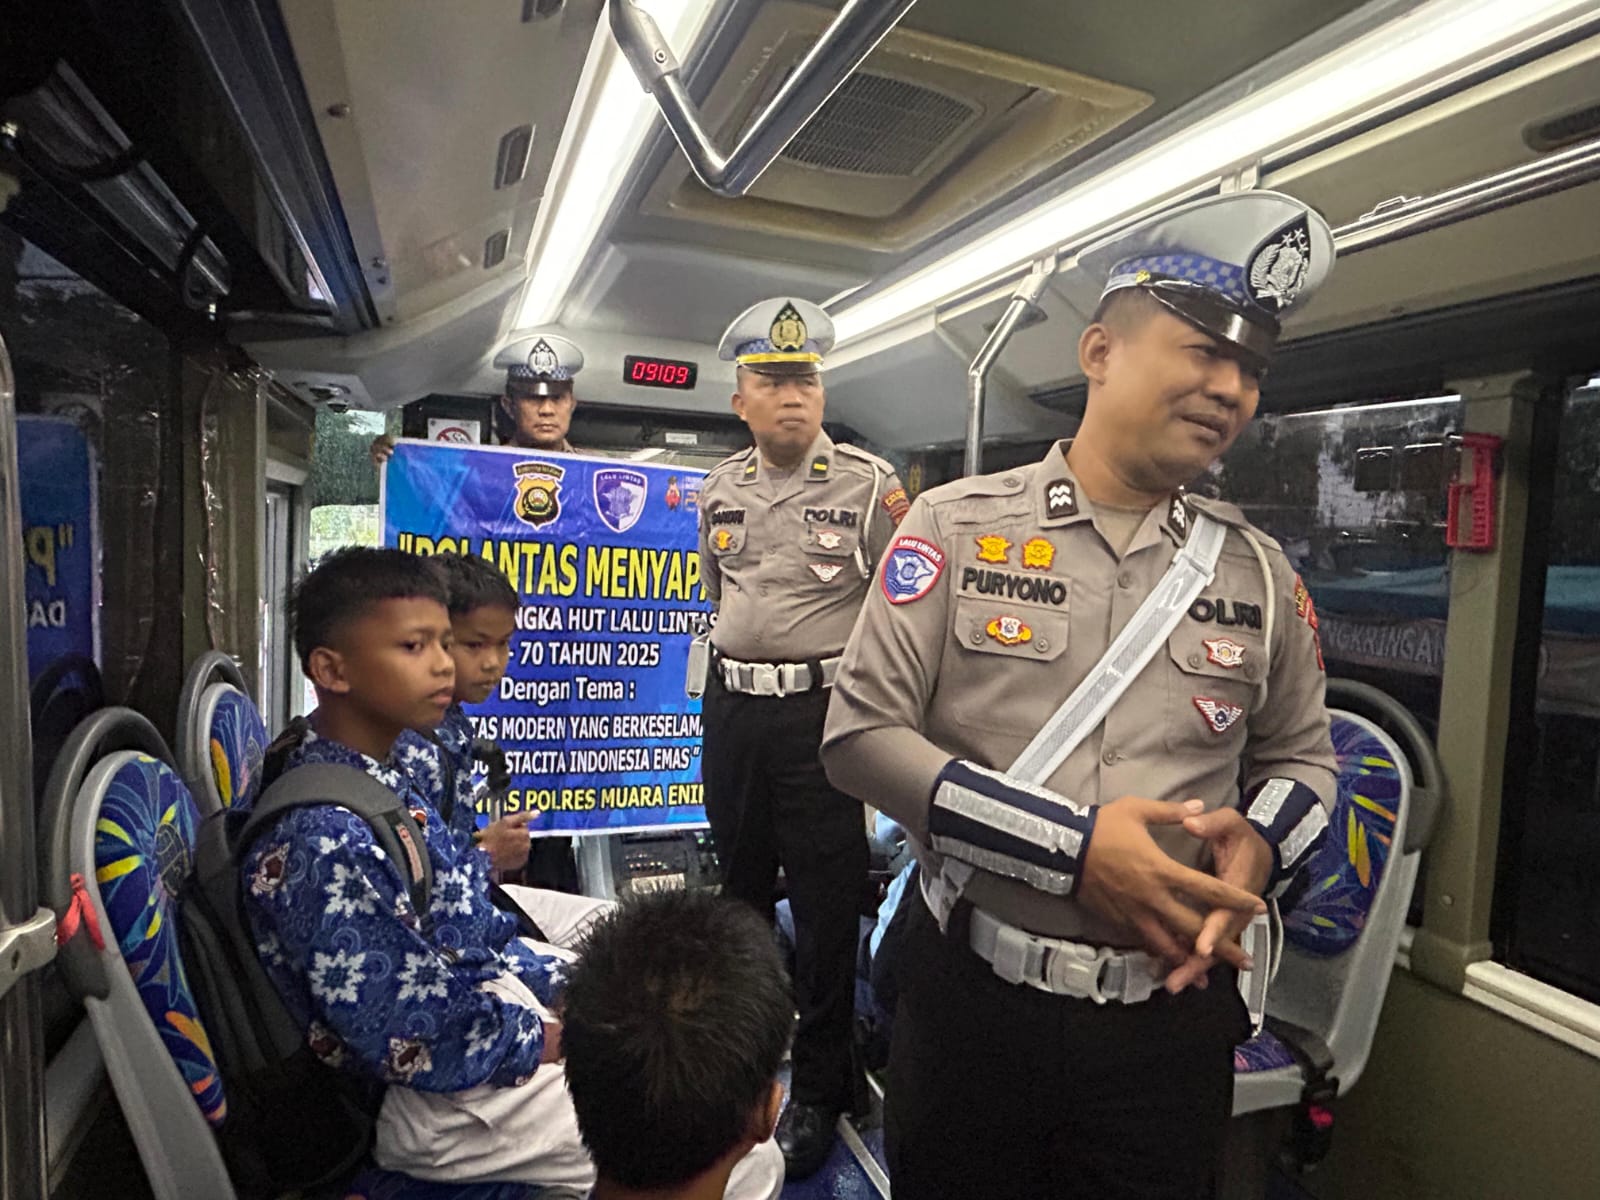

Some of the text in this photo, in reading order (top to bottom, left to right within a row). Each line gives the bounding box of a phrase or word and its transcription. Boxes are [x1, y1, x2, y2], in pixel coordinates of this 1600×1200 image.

[804, 508, 857, 527] POLRI
[585, 546, 707, 601] MENYAP
[961, 566, 1066, 605] PURYONO
[568, 608, 606, 631] HUT
[610, 609, 653, 632] LALU
[1188, 598, 1262, 630] OLRI
[520, 641, 544, 665] 70
[549, 642, 611, 666] TAHUN
[616, 643, 660, 666] 2025
[500, 677, 570, 706] Dengan
[575, 677, 624, 699] Tema
[501, 717, 566, 740] MODERN
[569, 716, 609, 739] YANG
[612, 715, 703, 738] BERKESELAM
[569, 748, 650, 773] INDONESIA
[526, 788, 597, 812] POLRES
[600, 786, 663, 809] MUARA
